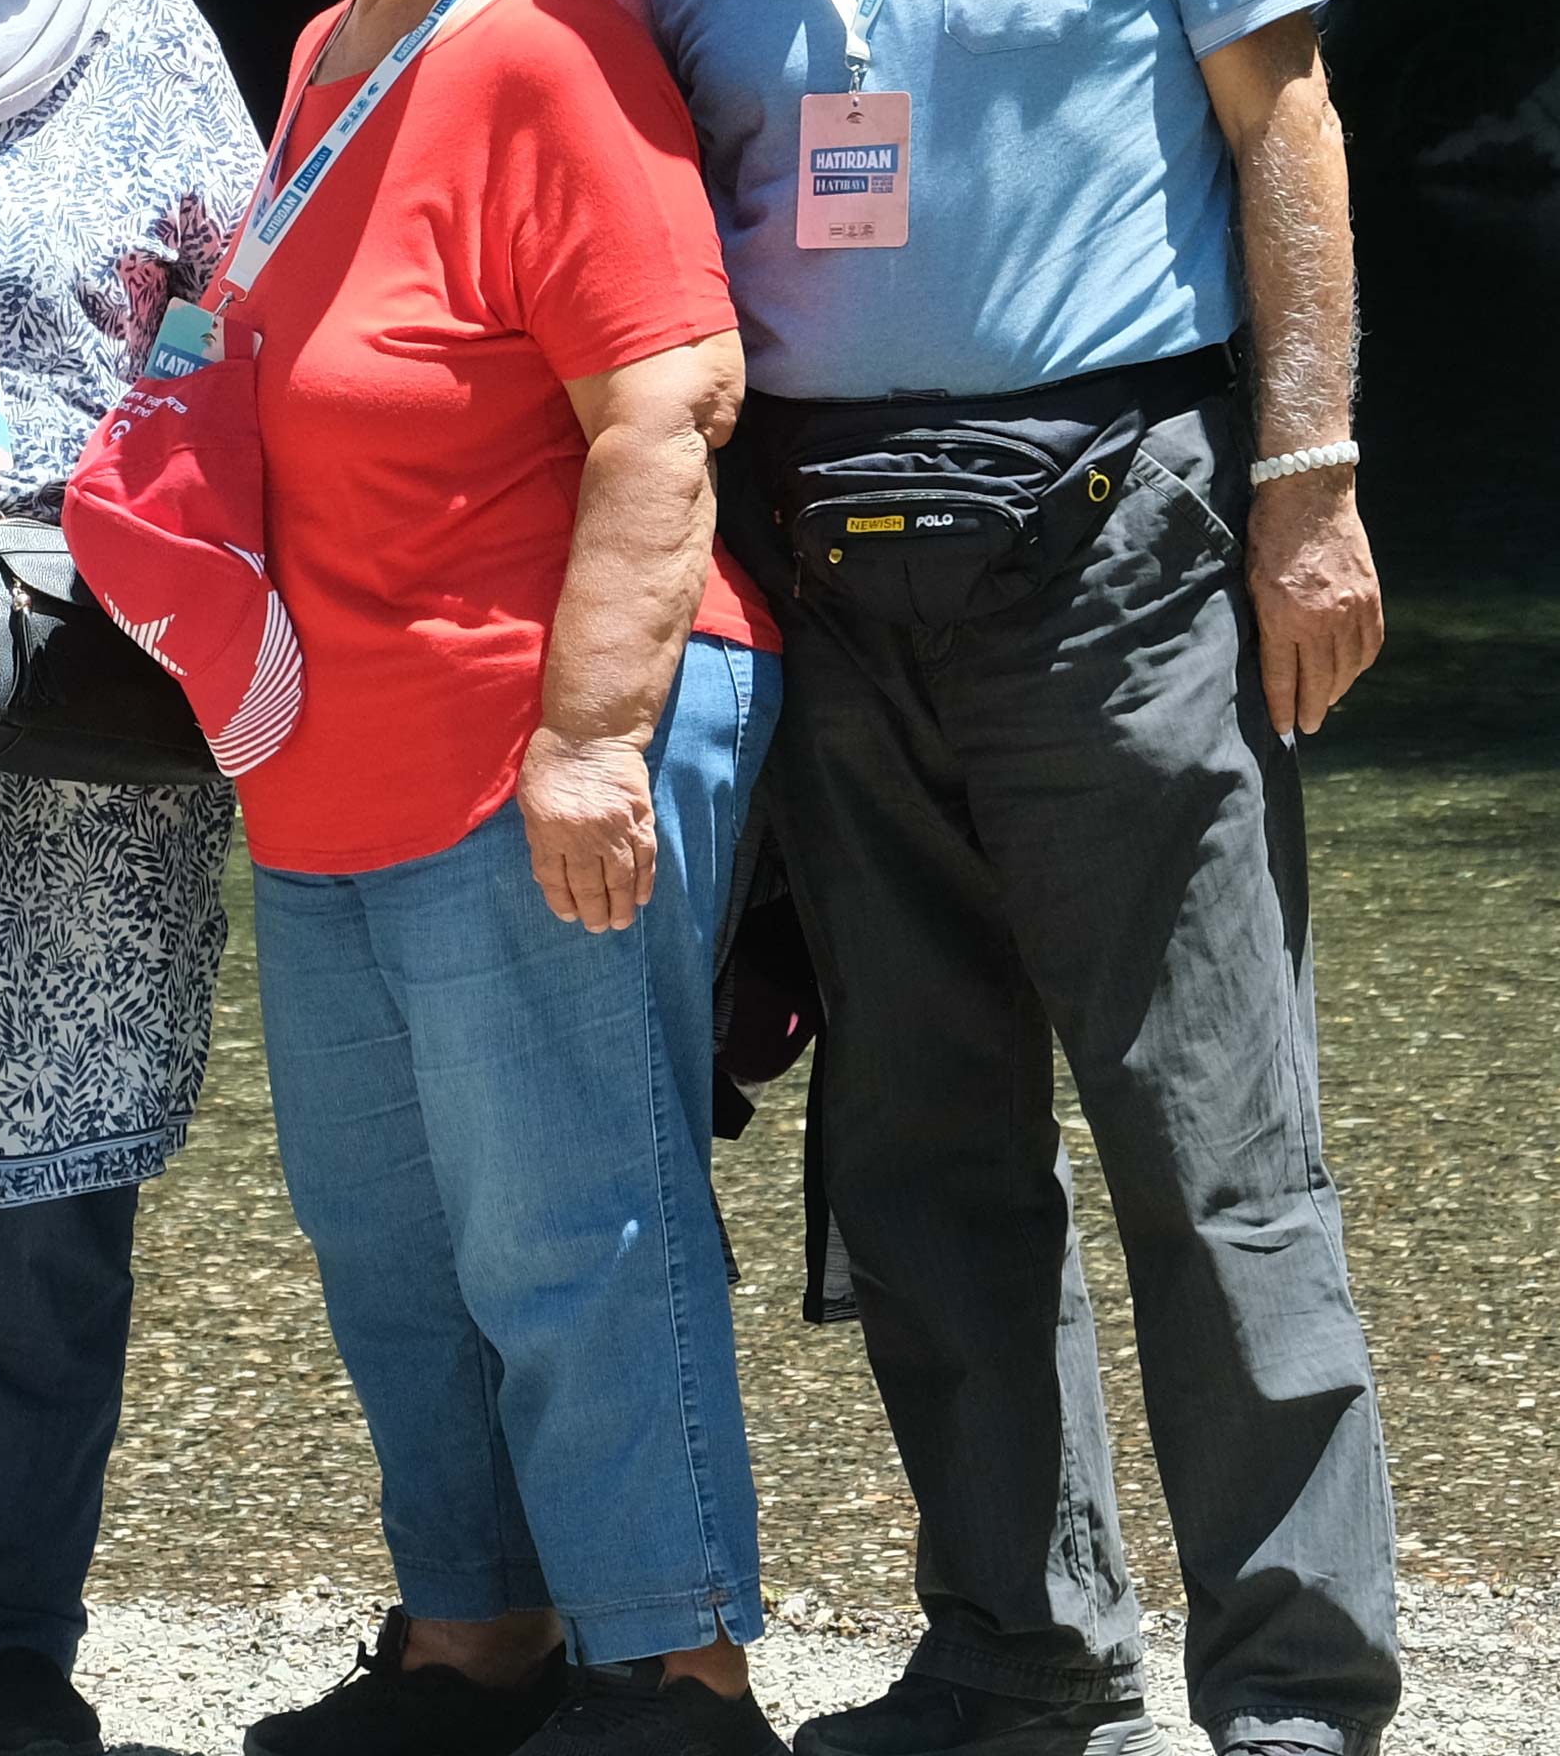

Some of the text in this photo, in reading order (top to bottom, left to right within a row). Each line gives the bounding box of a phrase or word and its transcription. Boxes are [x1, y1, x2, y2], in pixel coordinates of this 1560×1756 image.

[815, 149, 892, 170] HATIRDAN
[849, 513, 954, 531] NEWISH POLO
